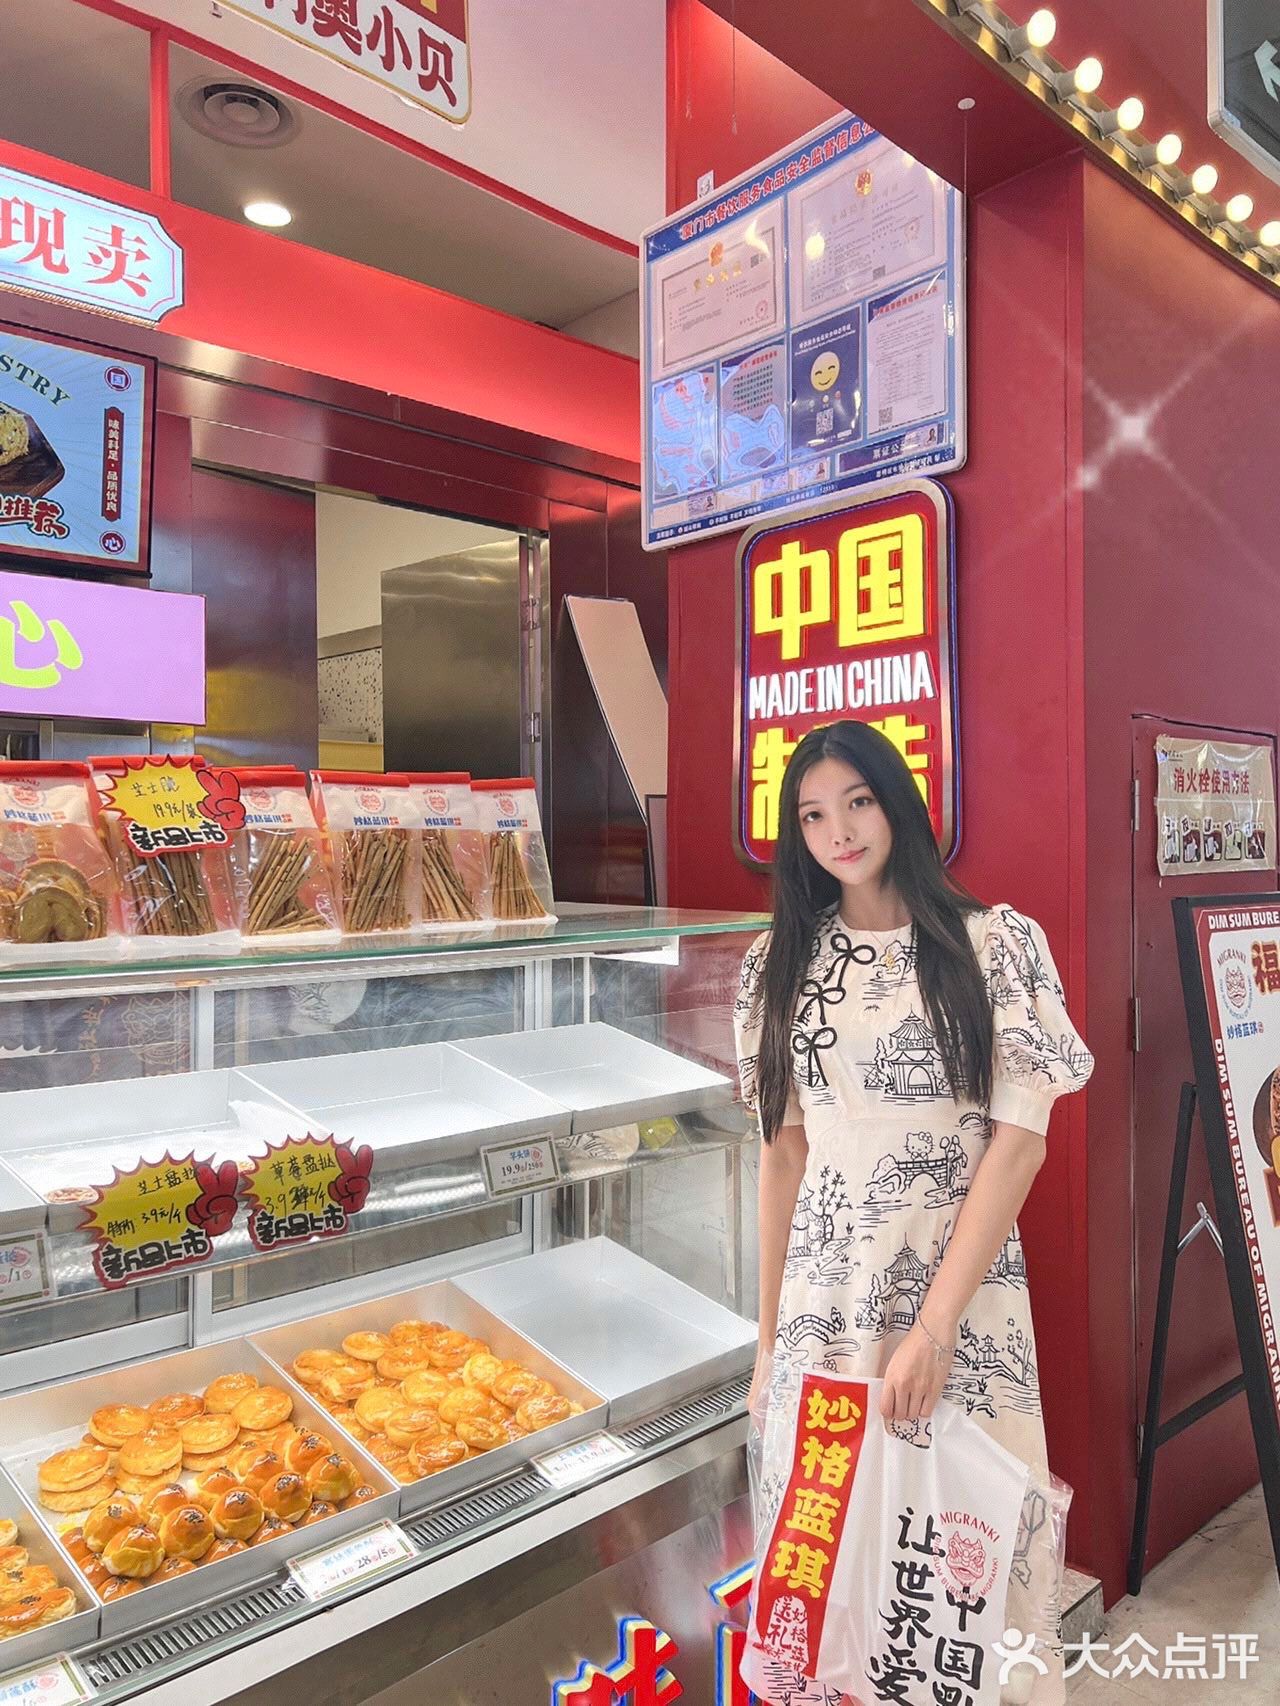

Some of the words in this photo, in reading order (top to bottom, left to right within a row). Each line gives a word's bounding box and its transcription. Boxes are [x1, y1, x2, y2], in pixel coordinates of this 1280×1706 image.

[0, 196, 152, 297] 现卖
[0, 497, 68, 536] 推荐
[754, 513, 928, 661] 中国
[0, 600, 84, 689] 心
[749, 669, 815, 720] MADE
[815, 664, 845, 714] IN
[847, 651, 935, 709] CHINA
[1174, 767, 1249, 794] 消火栓使用方法
[130, 820, 226, 851] 新品上市
[1208, 914, 1229, 930] DIM
[1228, 912, 1251, 927] SUM
[1251, 911, 1280, 926] BURE
[1251, 941, 1280, 996] 福
[1214, 1038, 1228, 1084] DIM
[1222, 1088, 1238, 1140] SUM
[1231, 1143, 1257, 1239] BUREAU
[1250, 1245, 1264, 1277] OF
[255, 1203, 345, 1246] 新品上市
[101, 1228, 208, 1280] 新品上市
[769, 1388, 862, 1598] 妙格蓝琪
[939, 1511, 1001, 1543] MIGRANKI
[865, 1506, 946, 1706] 让世界爱
